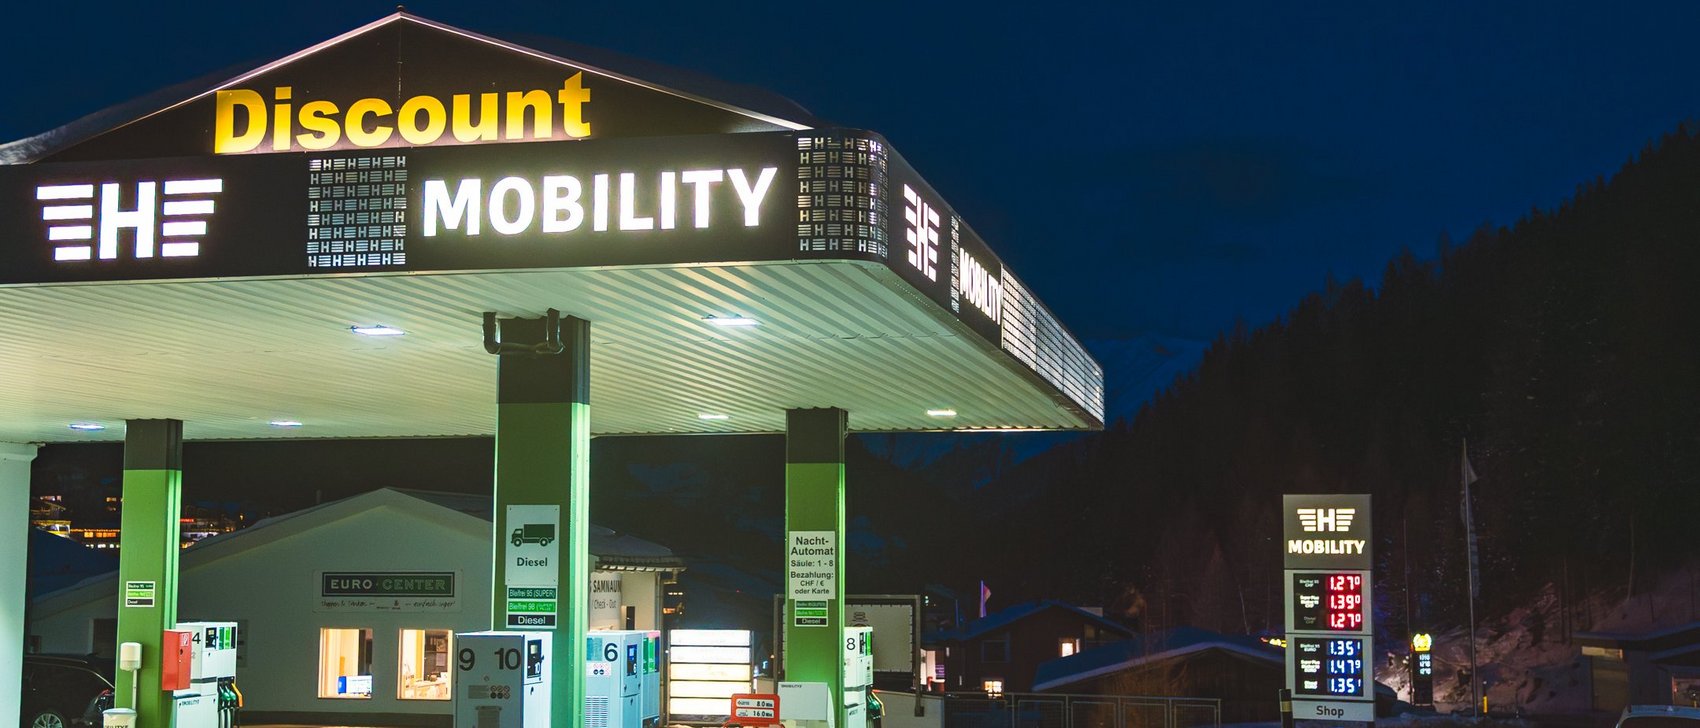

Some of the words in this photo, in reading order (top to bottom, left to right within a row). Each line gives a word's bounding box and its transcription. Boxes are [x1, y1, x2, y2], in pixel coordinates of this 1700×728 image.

[214, 71, 591, 154] Discount
[423, 167, 777, 236] MOBILITY
[959, 247, 1001, 325] MOBILITY
[796, 537, 829, 545] Nacht-
[1288, 540, 1365, 554] MOBILITY
[791, 547, 834, 555] Automat
[516, 557, 548, 567] Diesel
[790, 559, 815, 567] Säule:
[790, 571, 834, 580] Bezahlung:
[330, 579, 372, 590] EURO
[382, 579, 446, 591] CENTER
[593, 580, 621, 593] SAMNAUN
[517, 616, 546, 625] Diesel
[192, 632, 201, 644] 4
[846, 637, 856, 650] 8
[604, 642, 618, 662] 6
[459, 648, 475, 671] 9
[494, 648, 521, 670] 10
[1316, 706, 1345, 719] Shop
